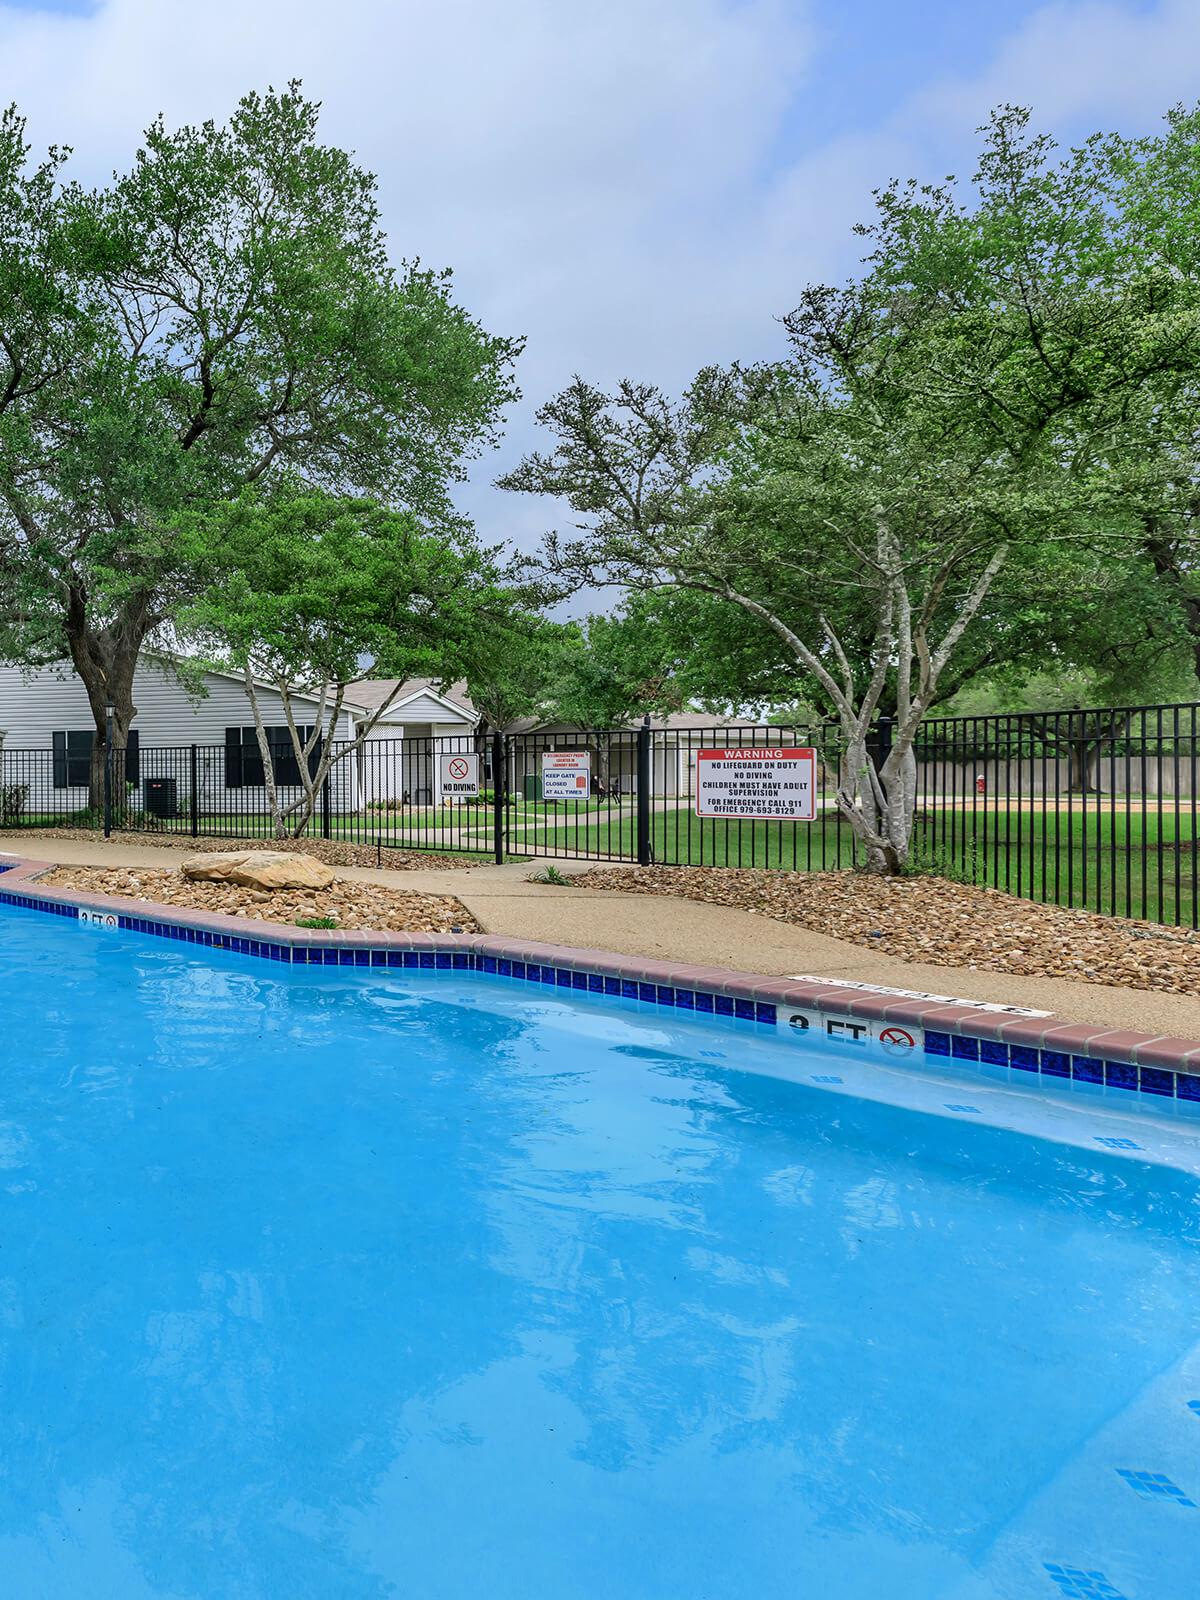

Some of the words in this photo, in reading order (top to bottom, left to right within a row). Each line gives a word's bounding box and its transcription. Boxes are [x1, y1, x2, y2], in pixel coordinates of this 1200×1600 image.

[724, 750, 784, 759] WARNING
[723, 799, 766, 807] EMERGENCY
[740, 806, 795, 815] 979-693-8129
[827, 1020, 866, 1039] FT
